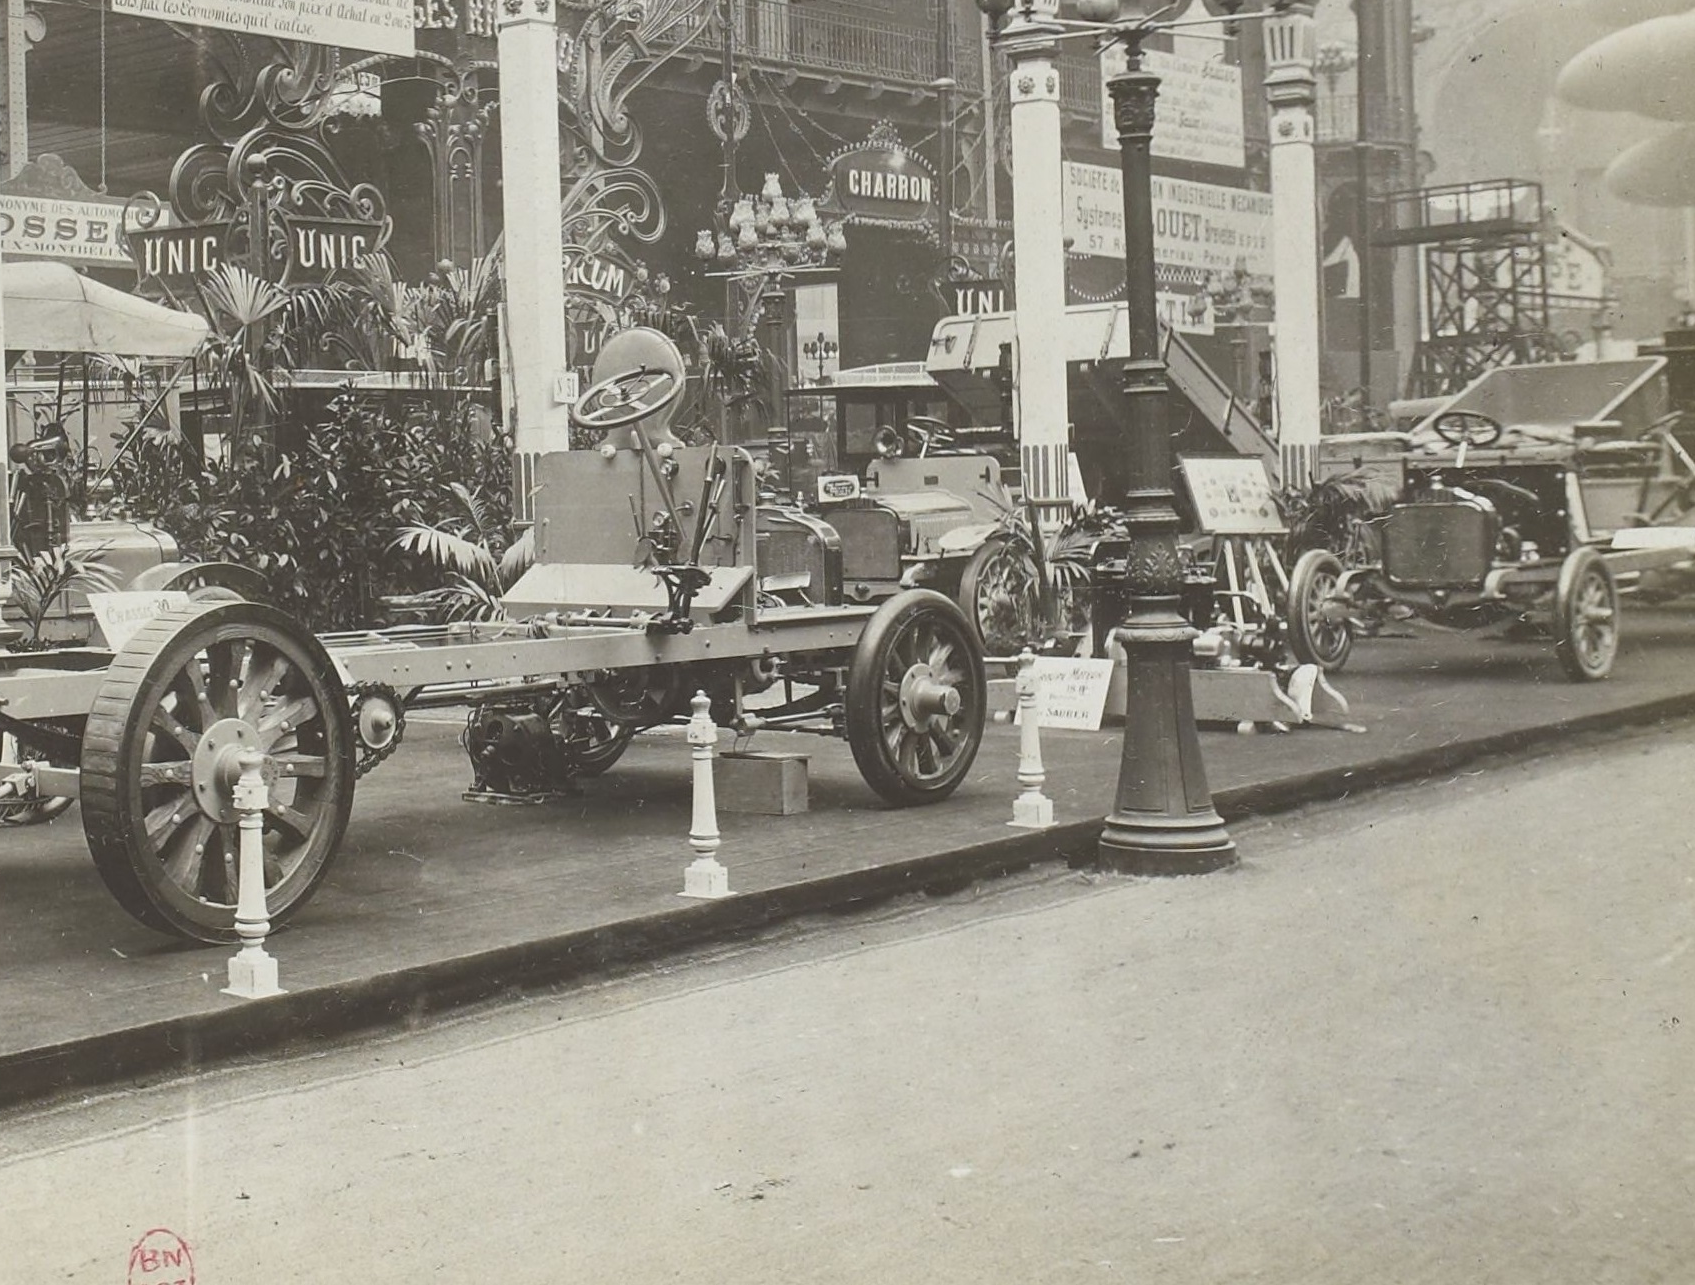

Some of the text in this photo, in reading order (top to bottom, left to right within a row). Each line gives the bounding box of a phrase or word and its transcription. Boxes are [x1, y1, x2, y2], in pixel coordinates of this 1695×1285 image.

[279, 0, 296, 11] son
[849, 169, 931, 203] CHARRON
[1168, 183, 1226, 210] INDUSTRIELLE
[144, 236, 217, 275] UNIC
[296, 227, 366, 270] UNIC
[1089, 236, 1104, 249] 57
